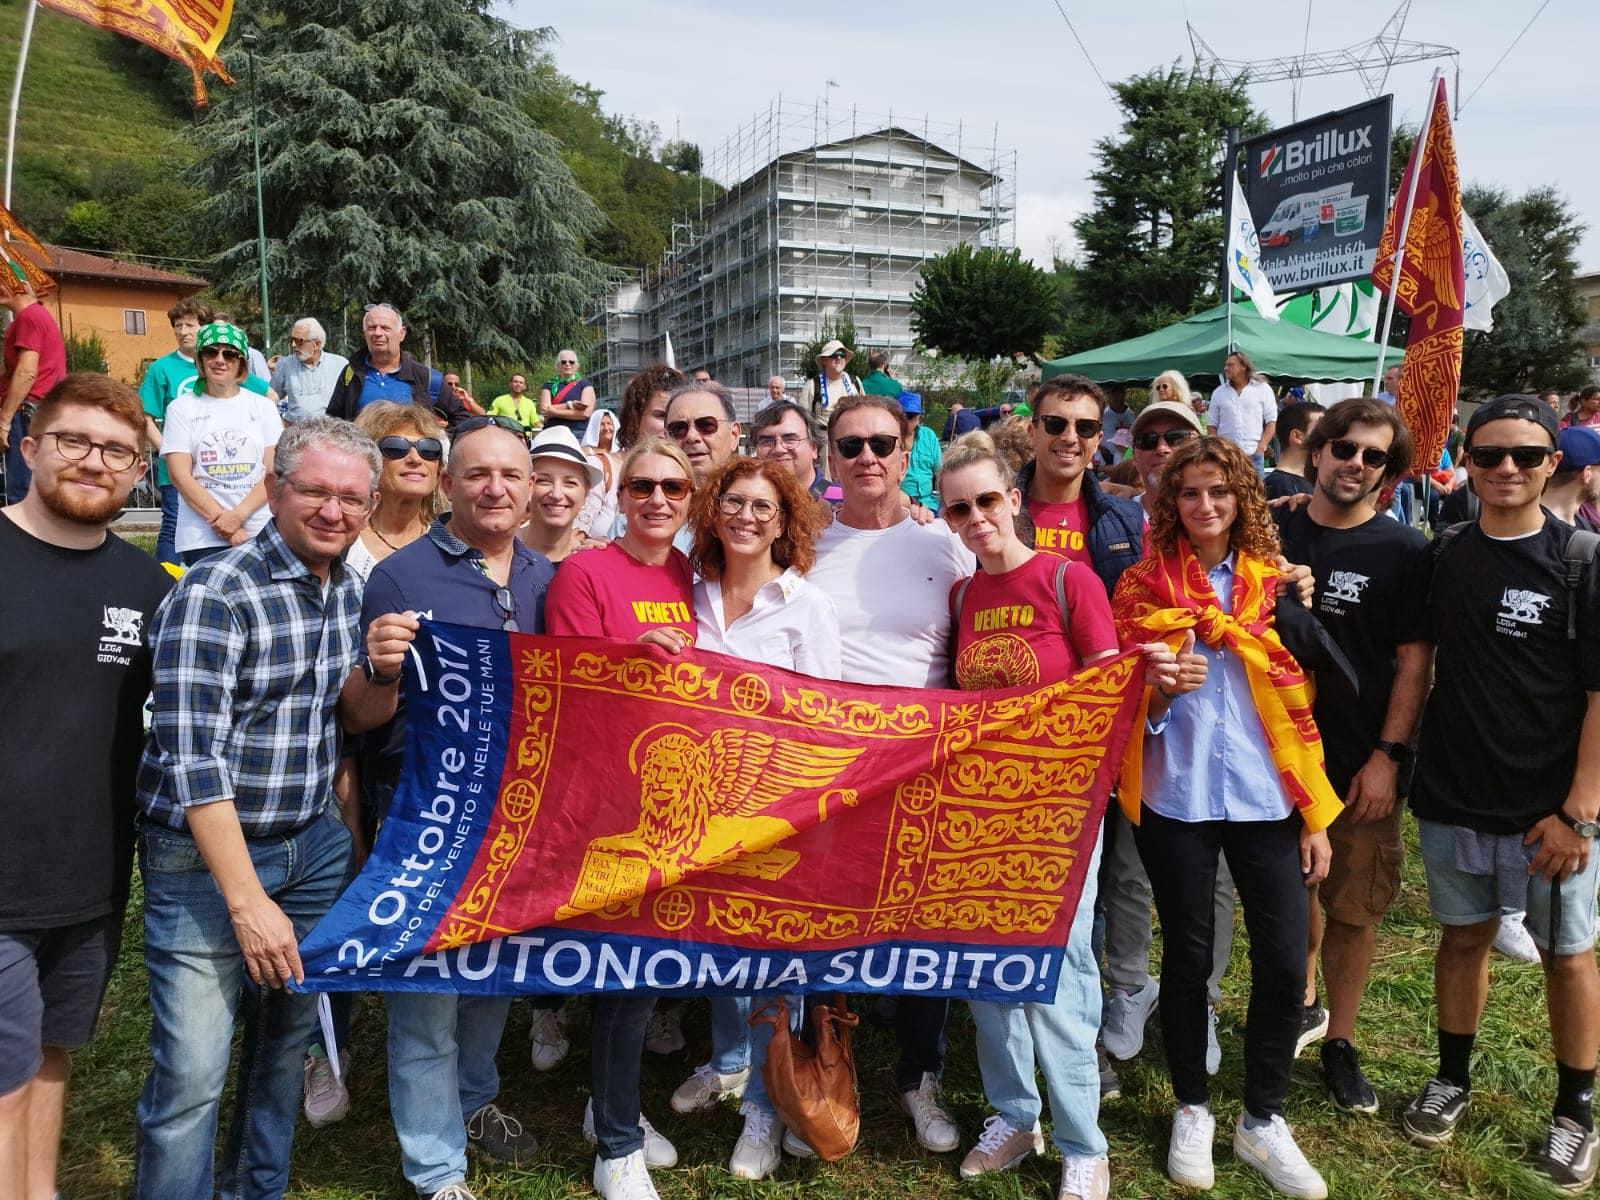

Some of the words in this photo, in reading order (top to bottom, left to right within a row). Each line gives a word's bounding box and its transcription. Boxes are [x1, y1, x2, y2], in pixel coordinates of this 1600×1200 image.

[1286, 125, 1372, 171] Brillux
[1311, 165, 1325, 181] più
[1328, 160, 1345, 174] che
[1347, 152, 1372, 169] colori
[1288, 243, 1343, 267] Matteotti
[1345, 239, 1366, 255] 6/h
[208, 463, 251, 475] SALVINI
[1036, 527, 1084, 550] NETO
[631, 601, 691, 623] VENETO
[974, 605, 1034, 631] VENETO
[1496, 617, 1516, 628] LEGA
[1495, 625, 1528, 639] GIOVANI
[97, 654, 131, 666] GIOVANI
[99, 643, 122, 653] LEGA
[476, 638, 495, 679] MANI
[480, 682, 495, 716] TUE
[473, 721, 492, 778] NELLE
[368, 747, 466, 926] Ottobre
[431, 635, 472, 733] 2017
[466, 782, 482, 795] È
[440, 799, 477, 873] VENETO
[593, 858, 610, 869] PAX
[418, 878, 448, 912] DEL
[381, 916, 423, 963] TURO
[404, 936, 808, 990] AUTONOMIA
[823, 948, 1052, 992] SUBITO!
